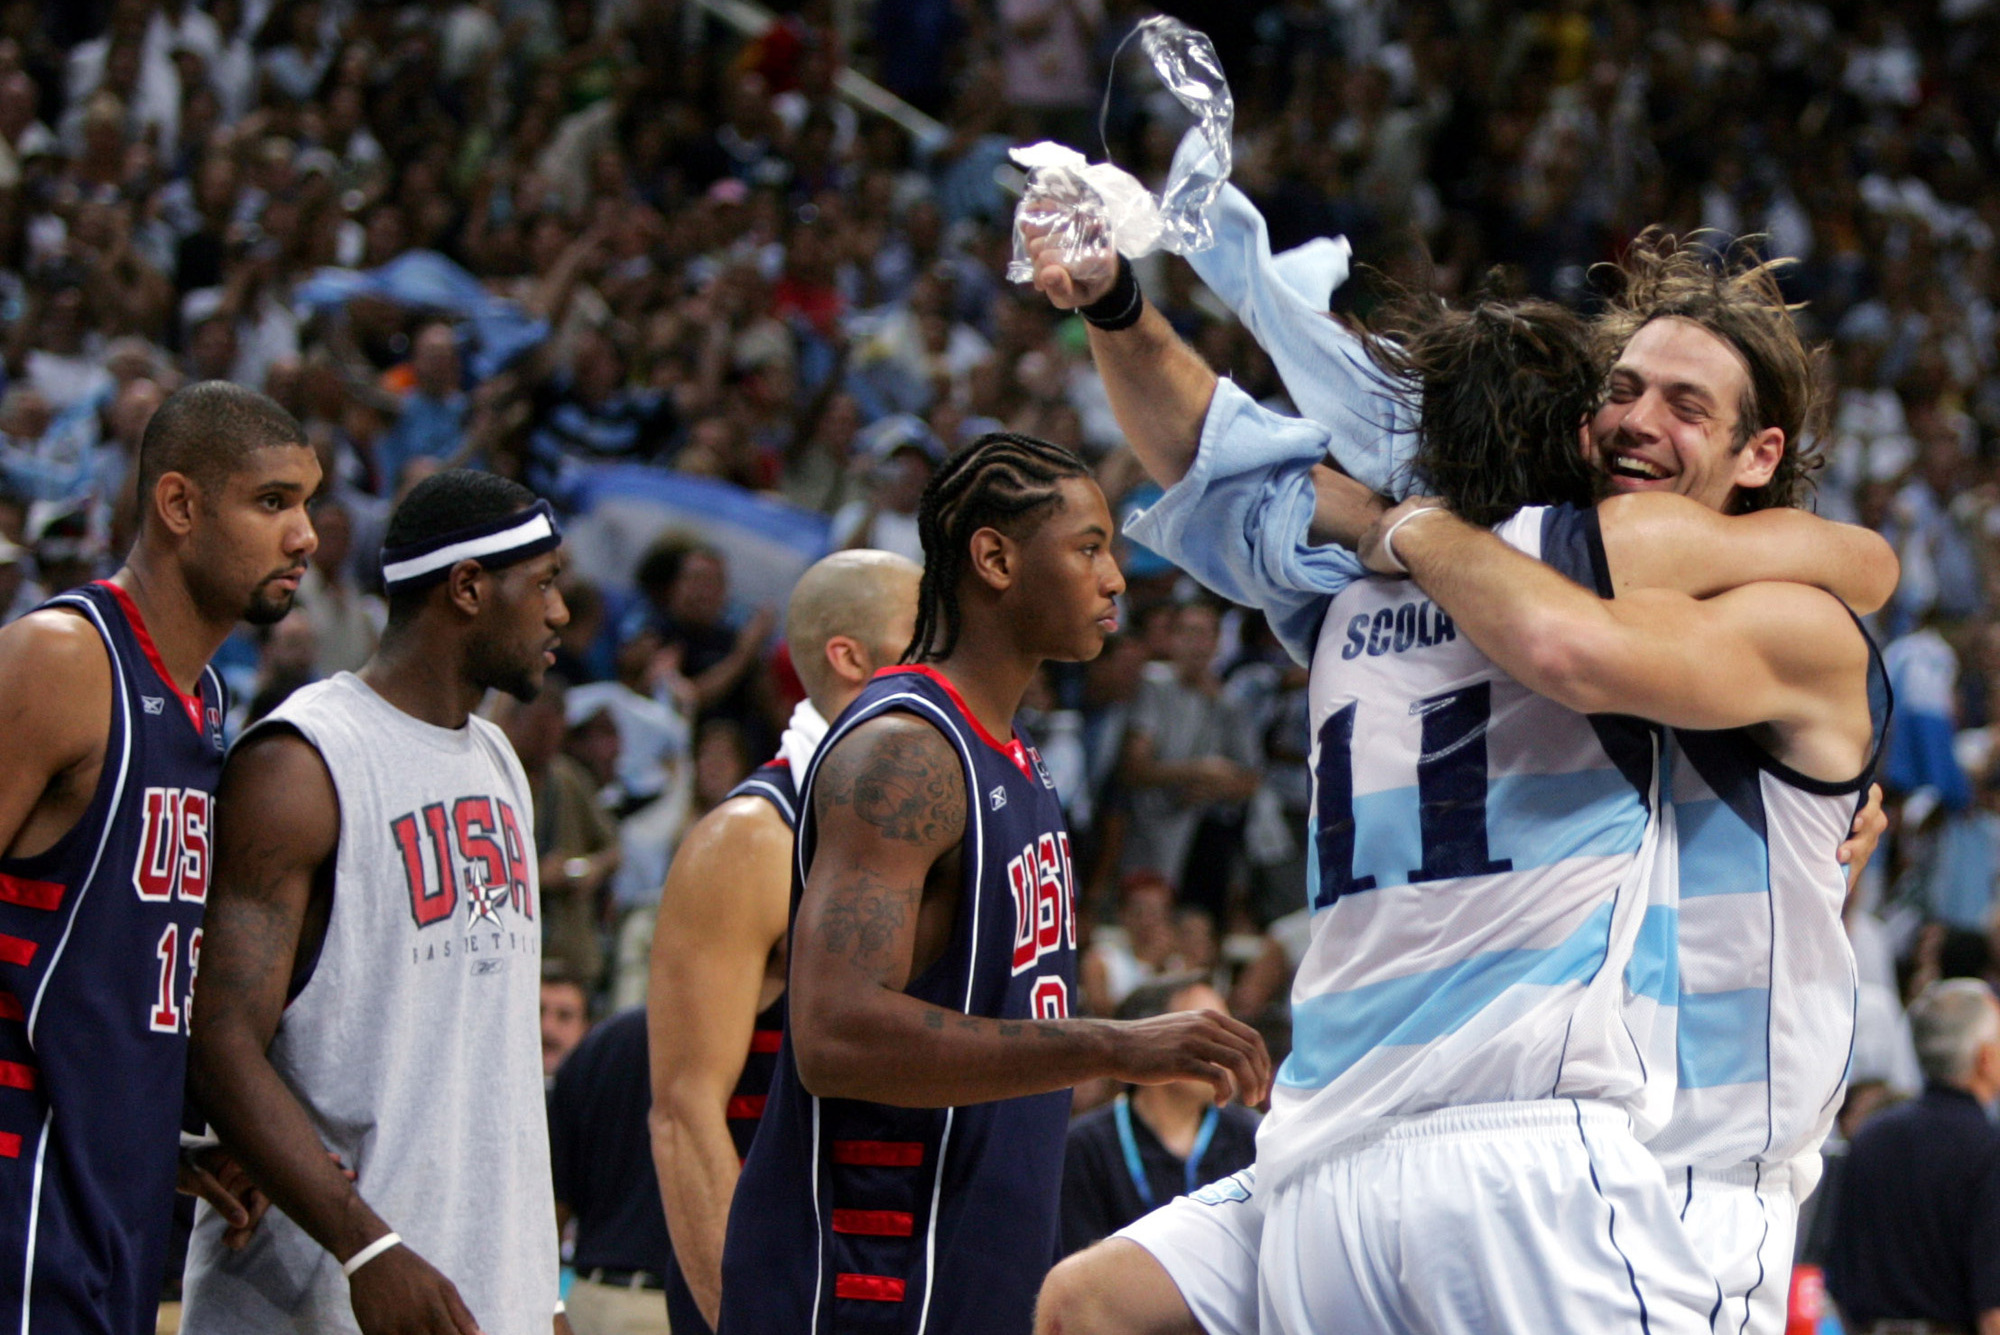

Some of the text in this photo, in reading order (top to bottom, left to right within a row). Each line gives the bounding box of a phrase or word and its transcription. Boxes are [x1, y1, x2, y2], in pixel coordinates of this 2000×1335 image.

[1341, 600, 1456, 660] SCOLA
[132, 787, 215, 902] US
[1314, 680, 1513, 910] 11
[390, 796, 533, 931] USA
